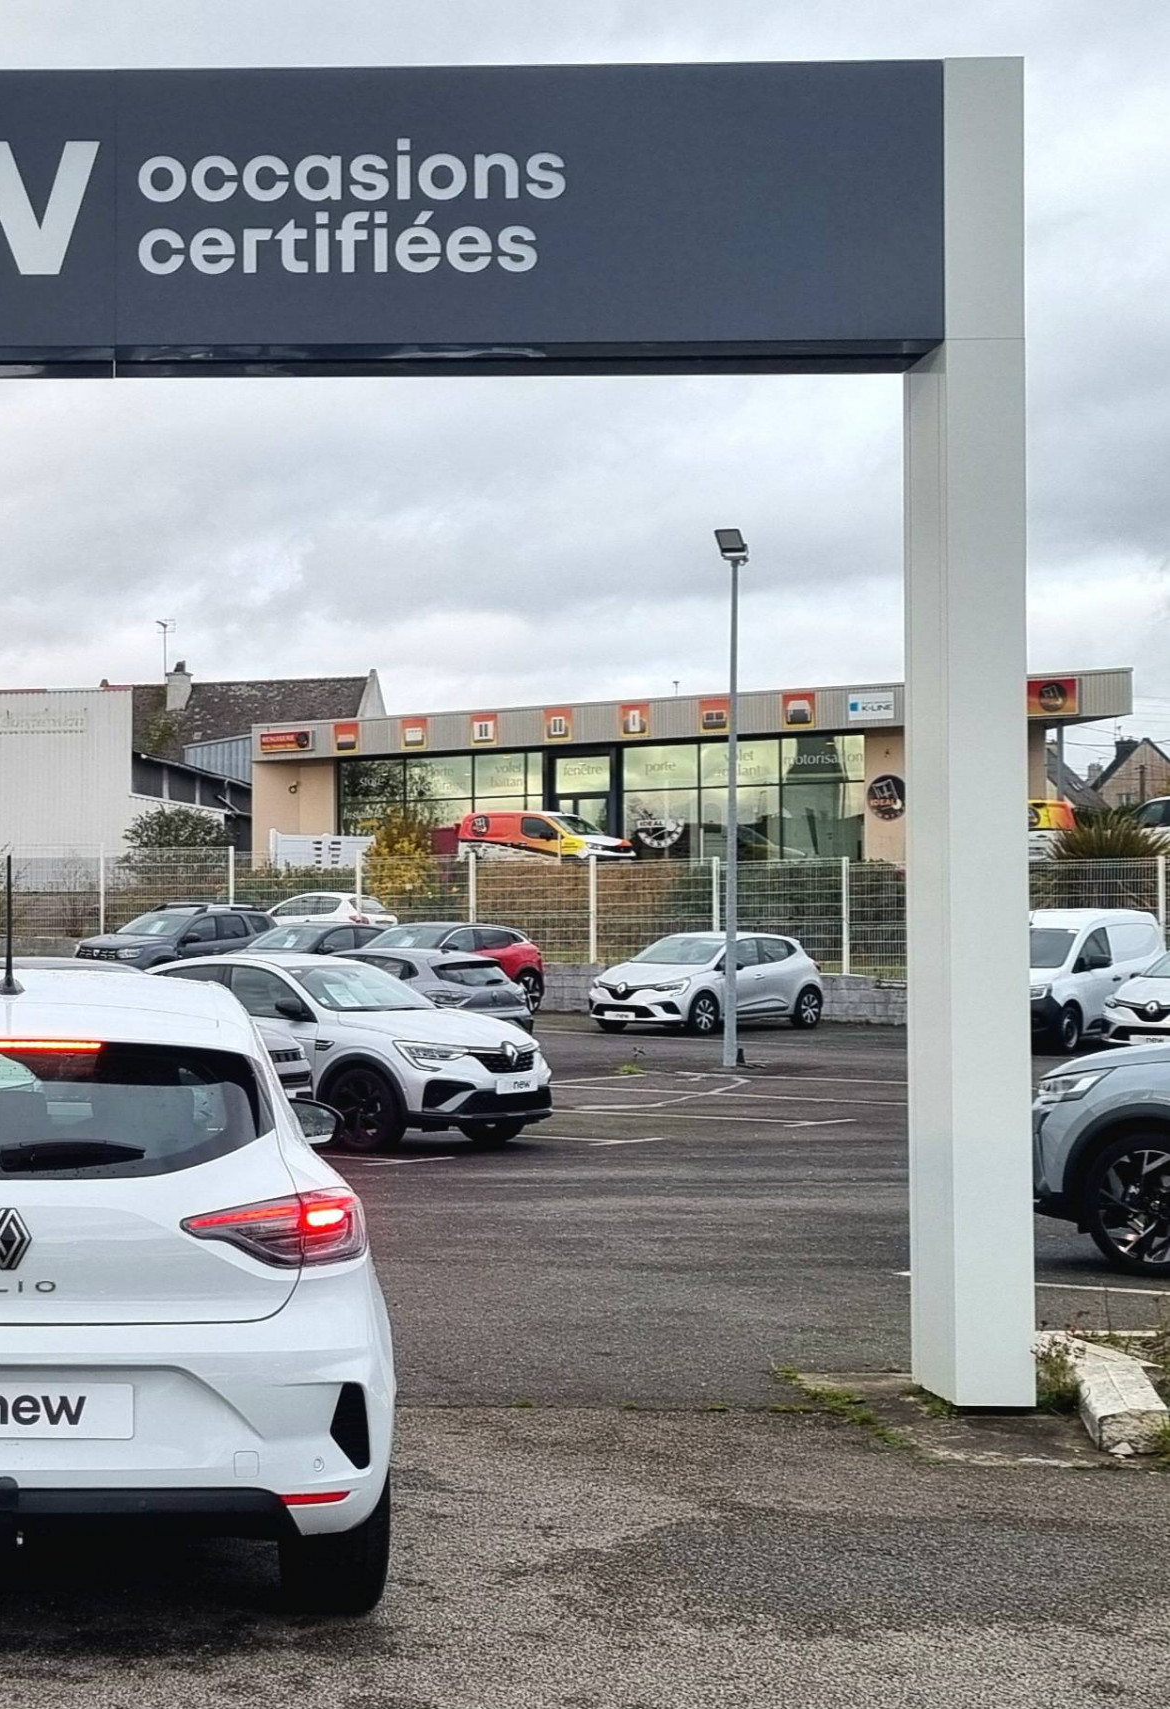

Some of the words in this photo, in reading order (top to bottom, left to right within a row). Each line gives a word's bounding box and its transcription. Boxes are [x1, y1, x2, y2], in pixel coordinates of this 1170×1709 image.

[137, 137, 568, 203] occasions
[137, 210, 539, 276] certifiées
[724, 749, 754, 761] vlet
[784, 750, 863, 765] motorisaon
